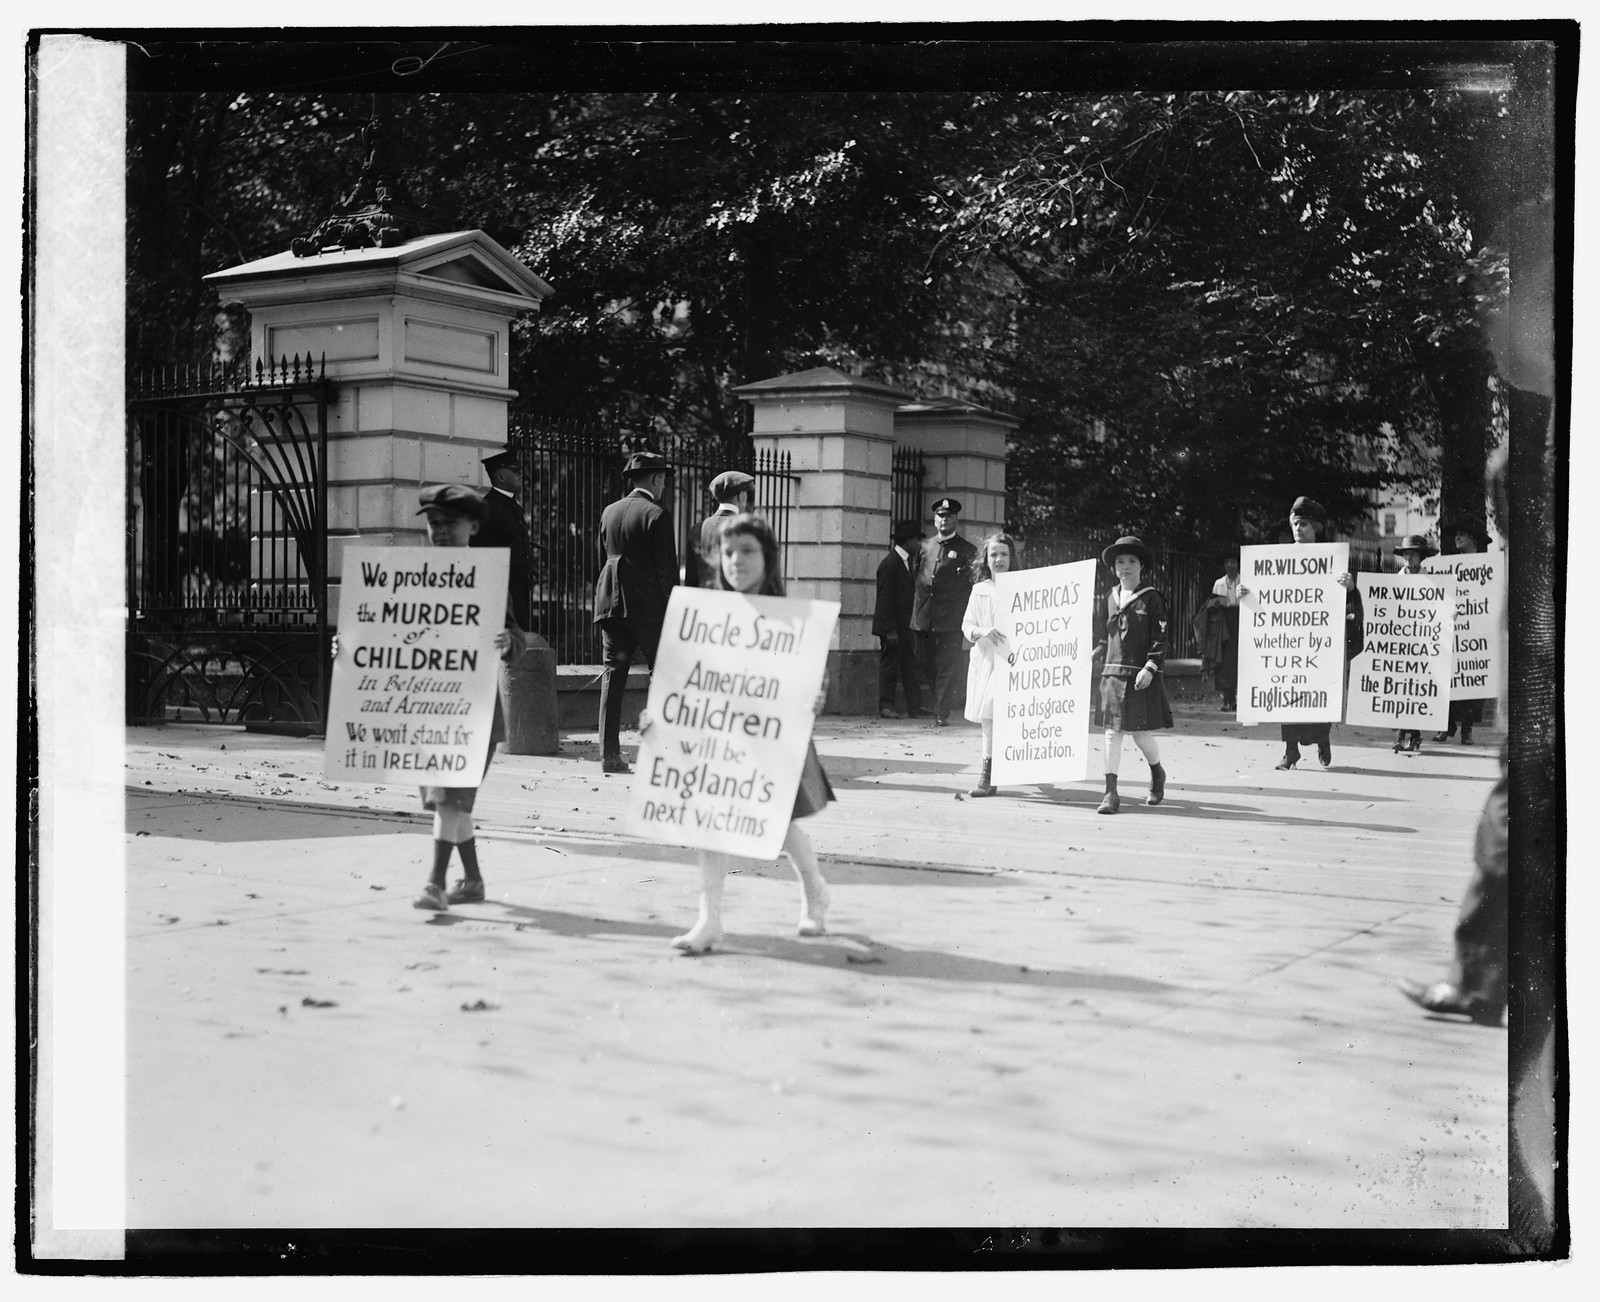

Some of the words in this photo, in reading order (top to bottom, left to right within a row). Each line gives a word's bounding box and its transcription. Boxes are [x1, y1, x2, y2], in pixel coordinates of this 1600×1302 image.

[362, 562, 387, 587] We
[393, 562, 476, 594] protested
[1455, 562, 1494, 587] George
[1011, 581, 1080, 613] AMERICA'S
[1259, 588, 1323, 604] MURDER
[1455, 586, 1470, 597] he
[357, 603, 376, 623] the
[382, 602, 480, 626] MURDER
[1374, 604, 1387, 618] is
[1398, 605, 1436, 623] busy
[1455, 597, 1489, 616] chist
[1016, 616, 1071, 637] POLICY
[1254, 612, 1266, 627] IS
[1272, 611, 1329, 626] MURDER
[1366, 619, 1441, 641] protecting
[403, 627, 431, 645] of
[679, 607, 740, 647] Uncle
[745, 614, 806, 656] Sam!
[1254, 633, 1304, 648] whether
[1309, 632, 1322, 652] by
[1324, 637, 1331, 647] a
[354, 646, 478, 672] CHILDREN
[1007, 643, 1023, 668] of
[1023, 637, 1078, 661] condoning
[1365, 640, 1440, 656] AMERICA'S
[1261, 656, 1318, 668] TURK
[1454, 657, 1491, 675] junior
[357, 675, 378, 691] in
[383, 674, 462, 694] Belgium
[684, 661, 779, 701] American
[1009, 665, 1072, 692] MURDER
[1271, 675, 1288, 683] or
[1292, 675, 1306, 683] an
[1361, 675, 1379, 693] the
[1384, 677, 1437, 697] British
[360, 696, 394, 714] and
[394, 695, 471, 715] Armenia
[1007, 700, 1017, 719] is
[1018, 703, 1026, 718] a
[1028, 696, 1074, 719] disgrace
[1251, 686, 1327, 712] Englishman
[1372, 695, 1433, 718] Empire.
[663, 692, 781, 740] Children
[346, 722, 366, 742] We
[411, 724, 450, 745] stand
[454, 725, 473, 745] for
[1022, 721, 1062, 740] before
[345, 749, 357, 768] it
[362, 751, 376, 768] in
[383, 750, 466, 771] IRELAND
[680, 737, 716, 759] will
[723, 738, 748, 765] be
[1005, 740, 1075, 762] Civilization.
[650, 756, 774, 804] England's
[643, 800, 687, 825] next
[695, 805, 767, 837] victims
